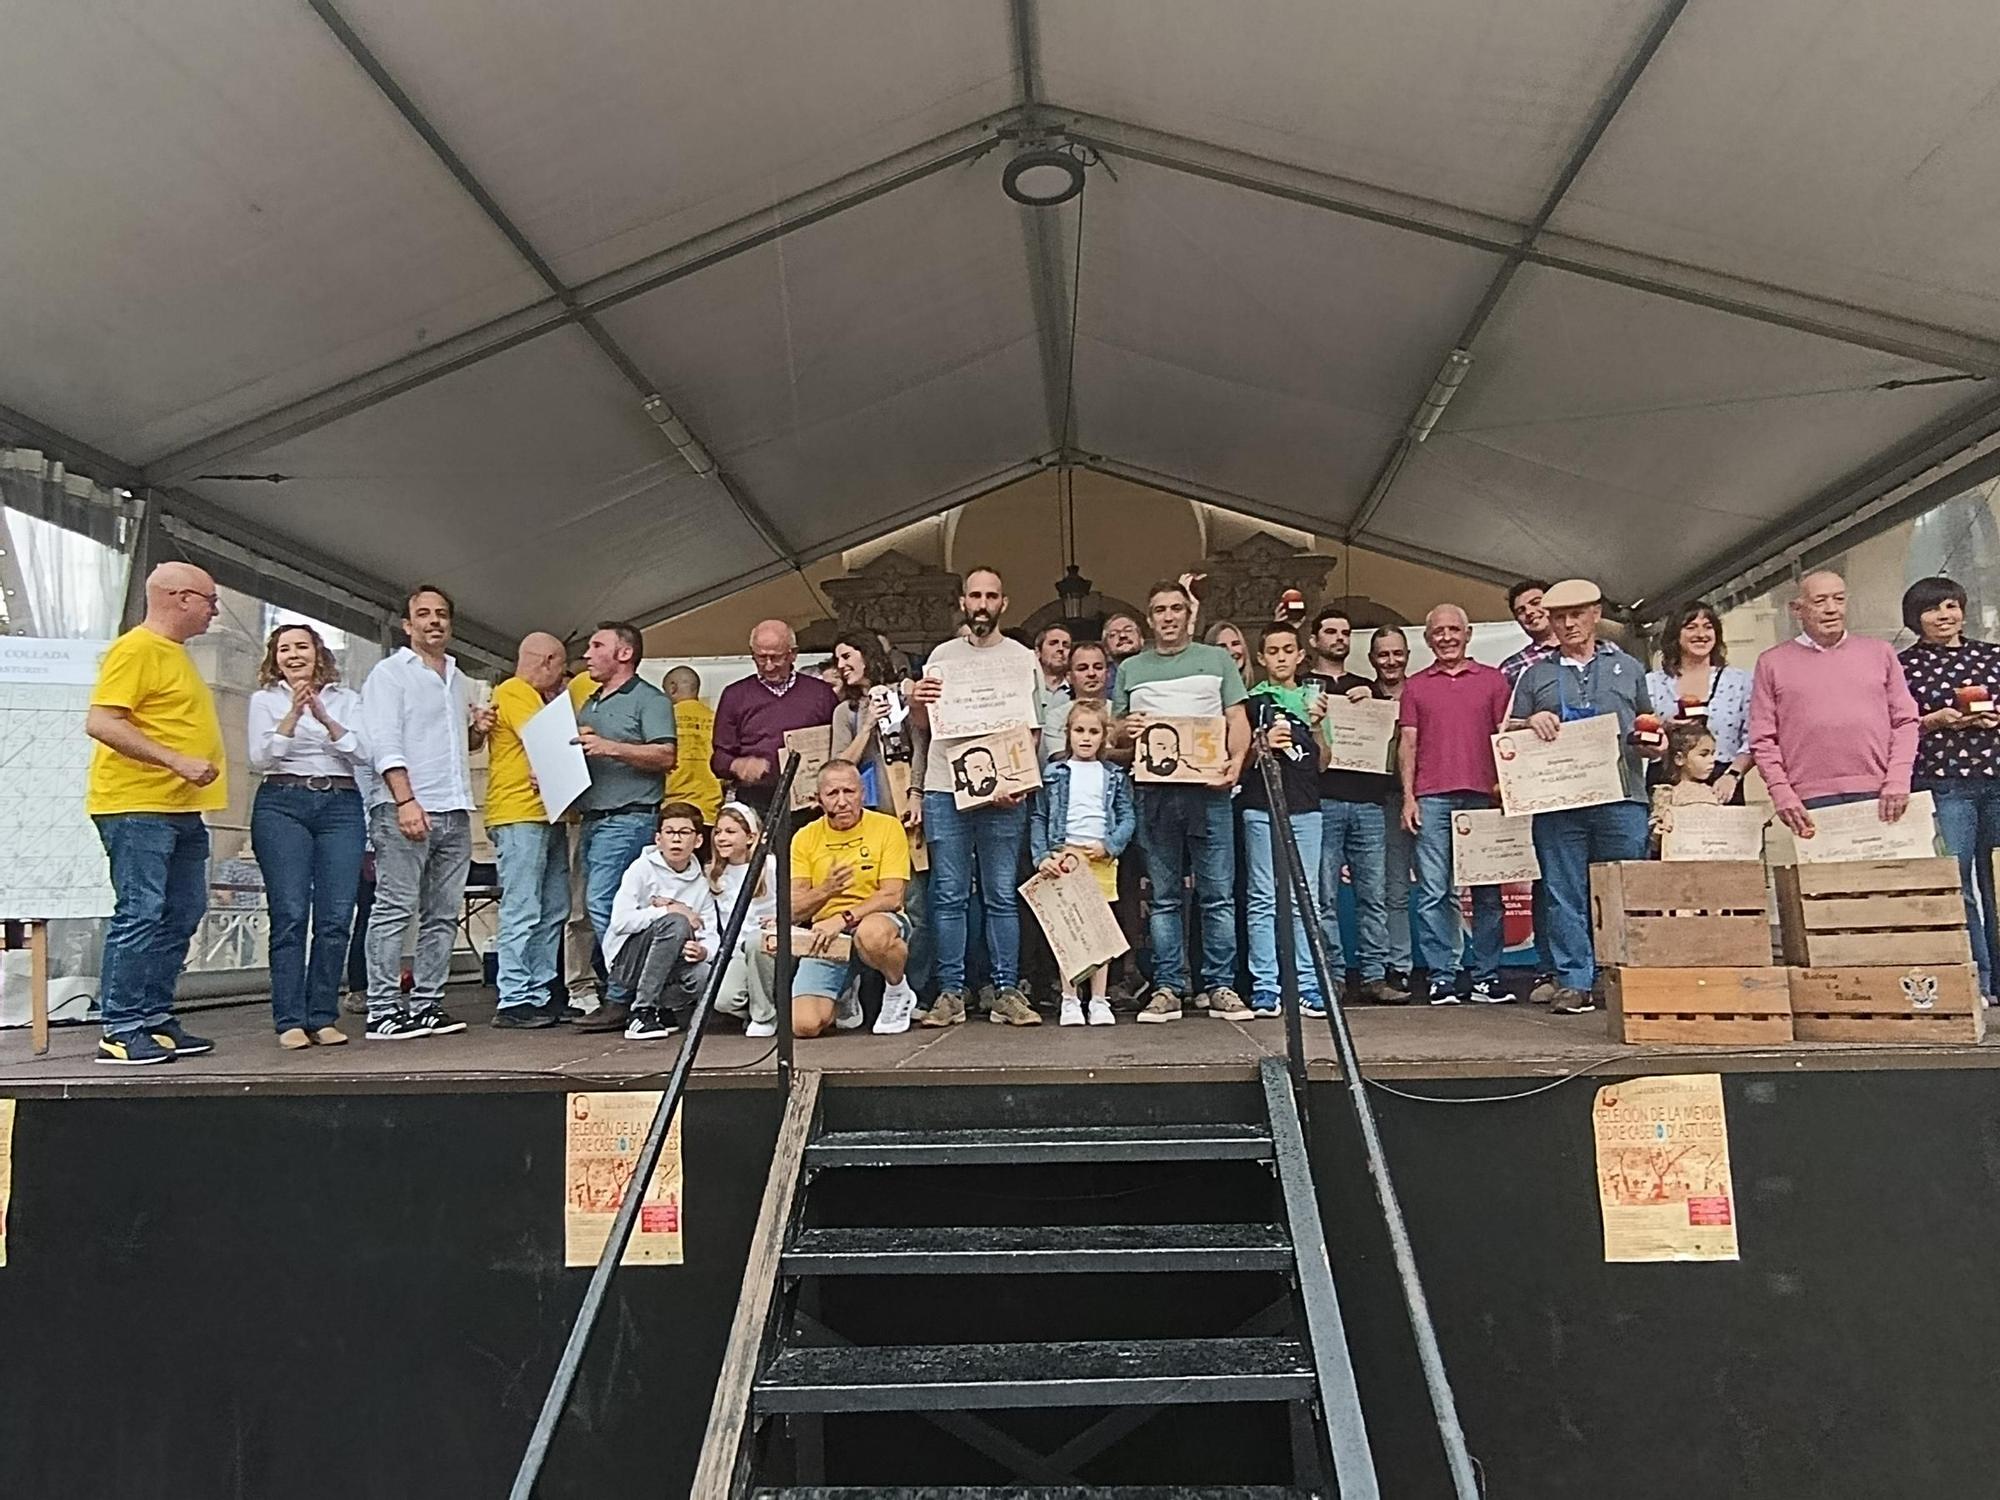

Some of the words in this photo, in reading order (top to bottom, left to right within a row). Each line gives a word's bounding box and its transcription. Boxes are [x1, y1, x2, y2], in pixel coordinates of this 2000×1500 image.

[4, 649, 70, 660] COLLADA
[1650, 1106, 1665, 1122] DE
[1667, 1105, 1681, 1122] LA
[615, 1121, 629, 1136] DE
[630, 1121, 642, 1136] LA
